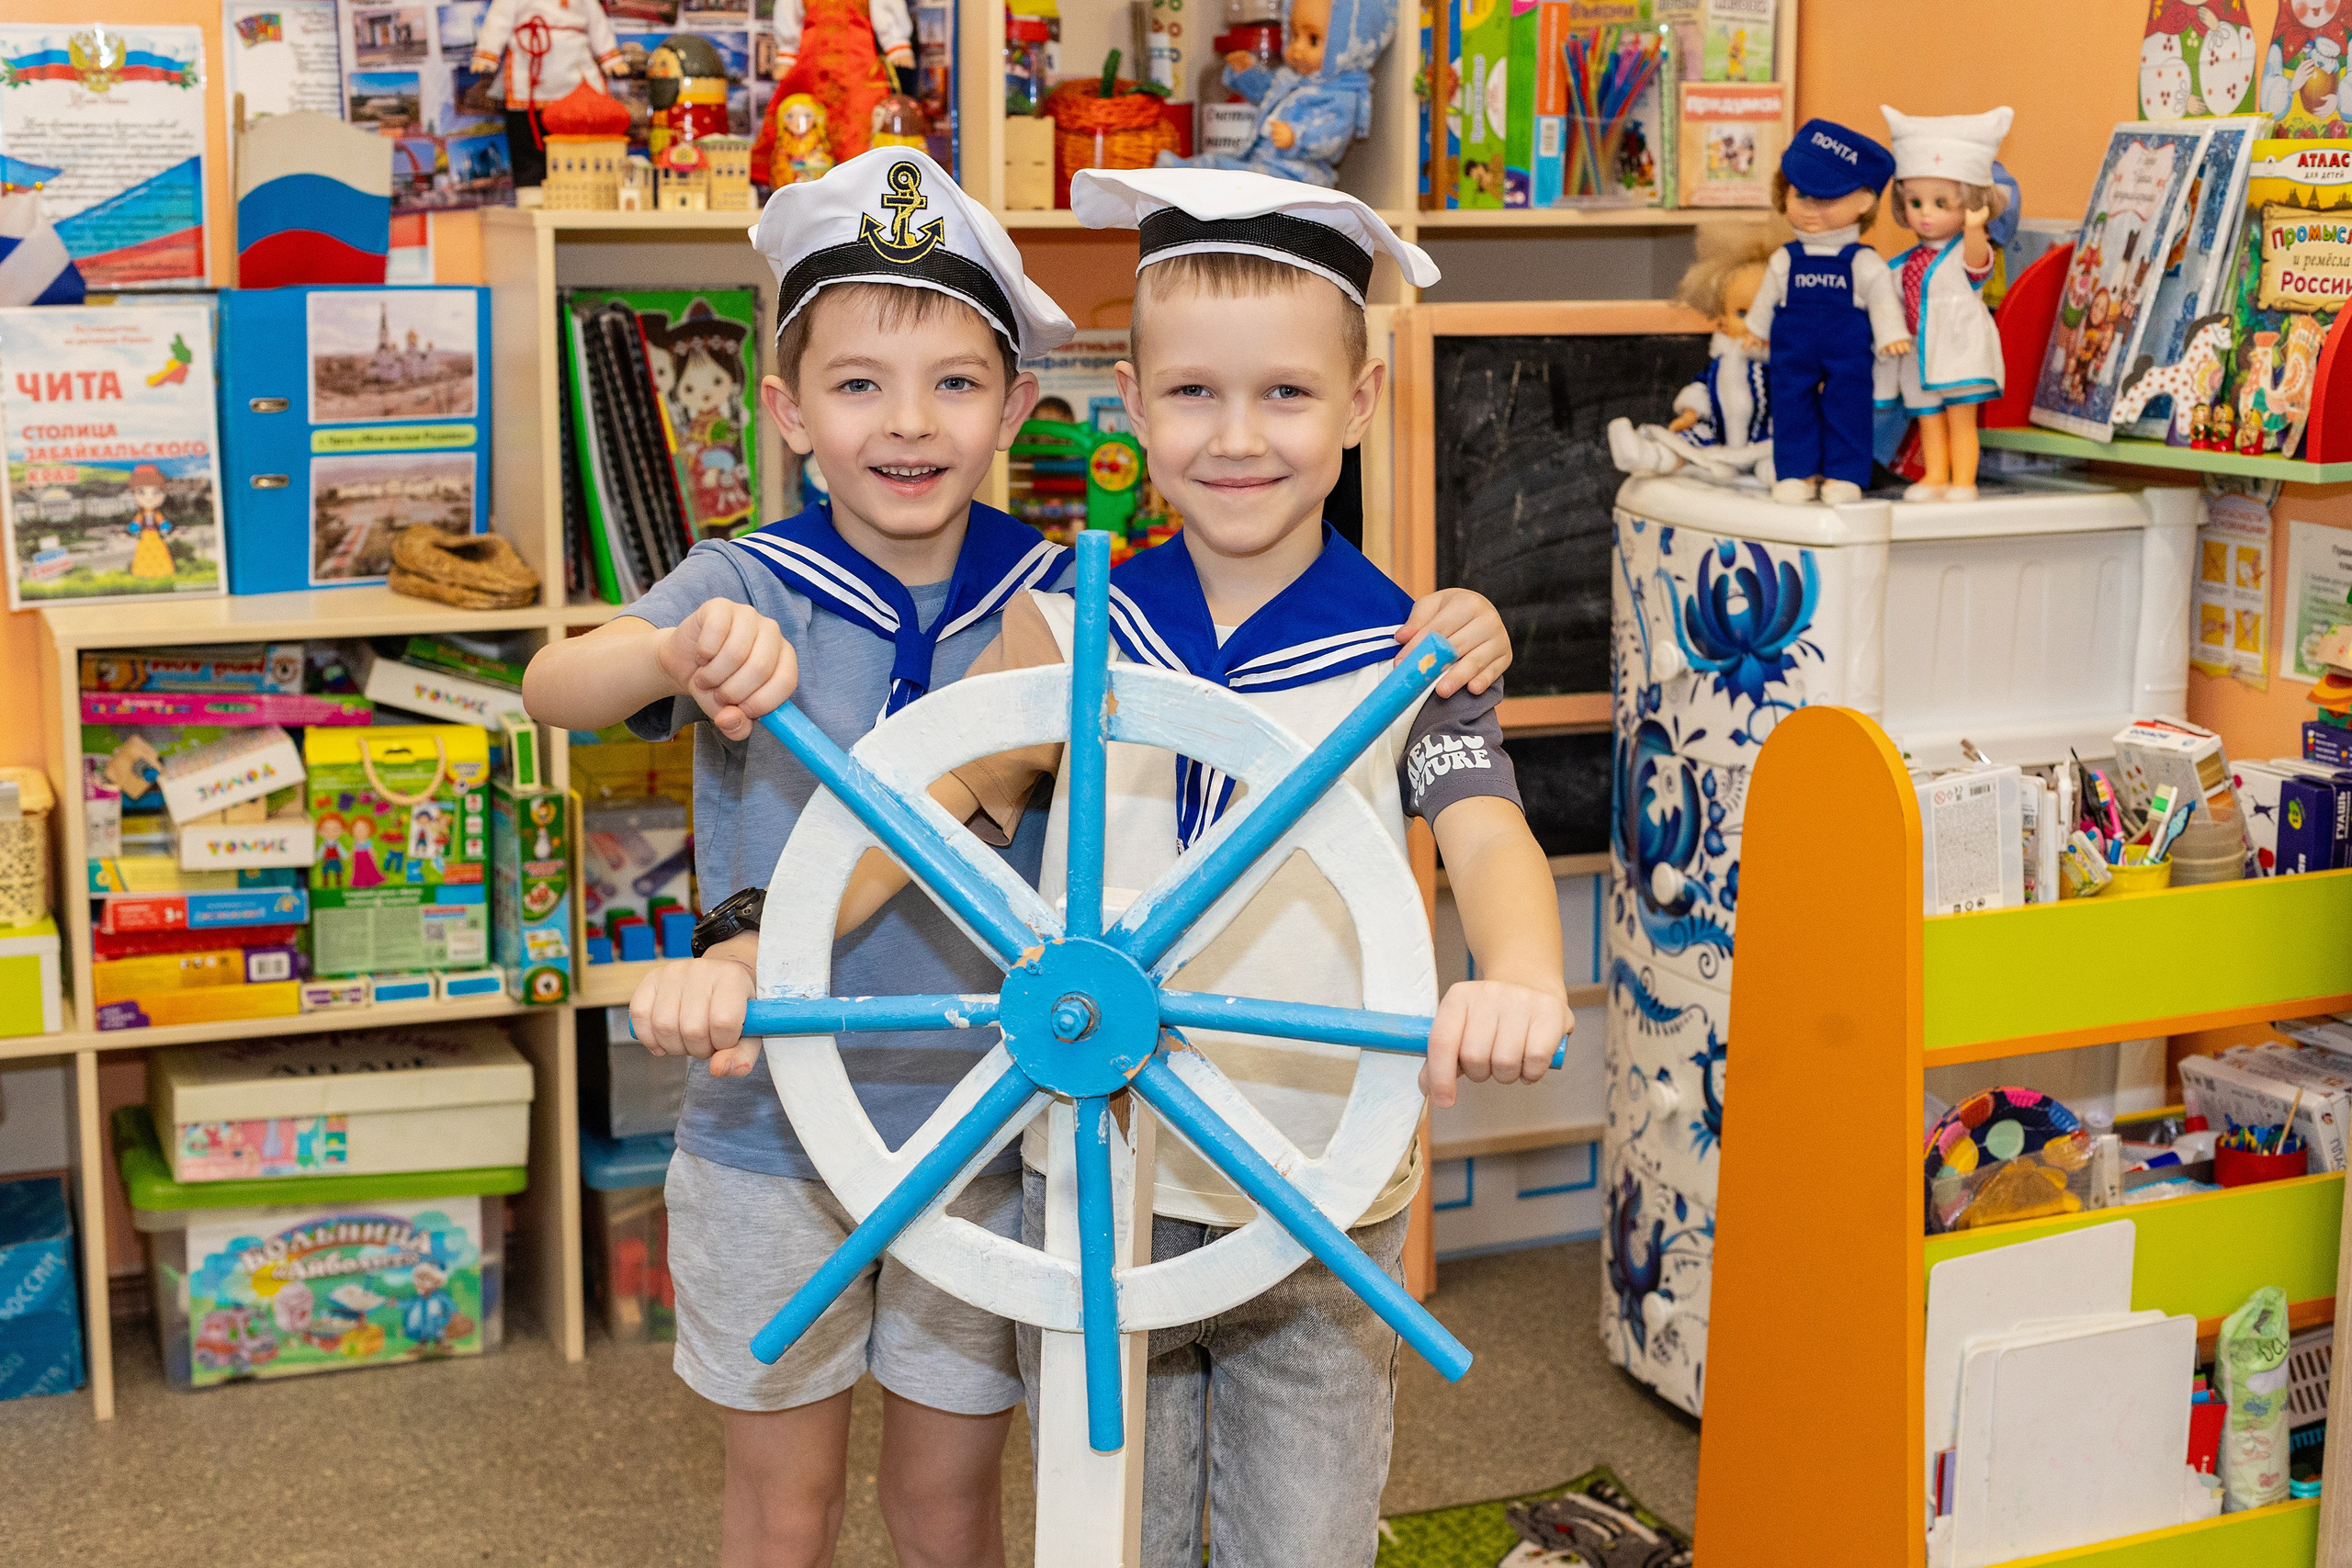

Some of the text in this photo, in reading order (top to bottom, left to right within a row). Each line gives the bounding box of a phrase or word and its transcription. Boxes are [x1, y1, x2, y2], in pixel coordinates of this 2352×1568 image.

[1811, 131, 1859, 165] ПОЧТА
[2297, 152, 2350, 168] АТЛАС
[2293, 252, 2350, 271] и ремёсла
[1794, 273, 1848, 289] ПОЧТА
[16, 370, 123, 401] ЧИТА
[21, 423, 119, 441] СТОЛИЦА
[24, 441, 208, 461] ЗАБАЙКАЛЬСКОГО
[2335, 790, 2346, 840] ГУАШЬ
[240, 1223, 431, 1274] БОЛЬНИЦА
